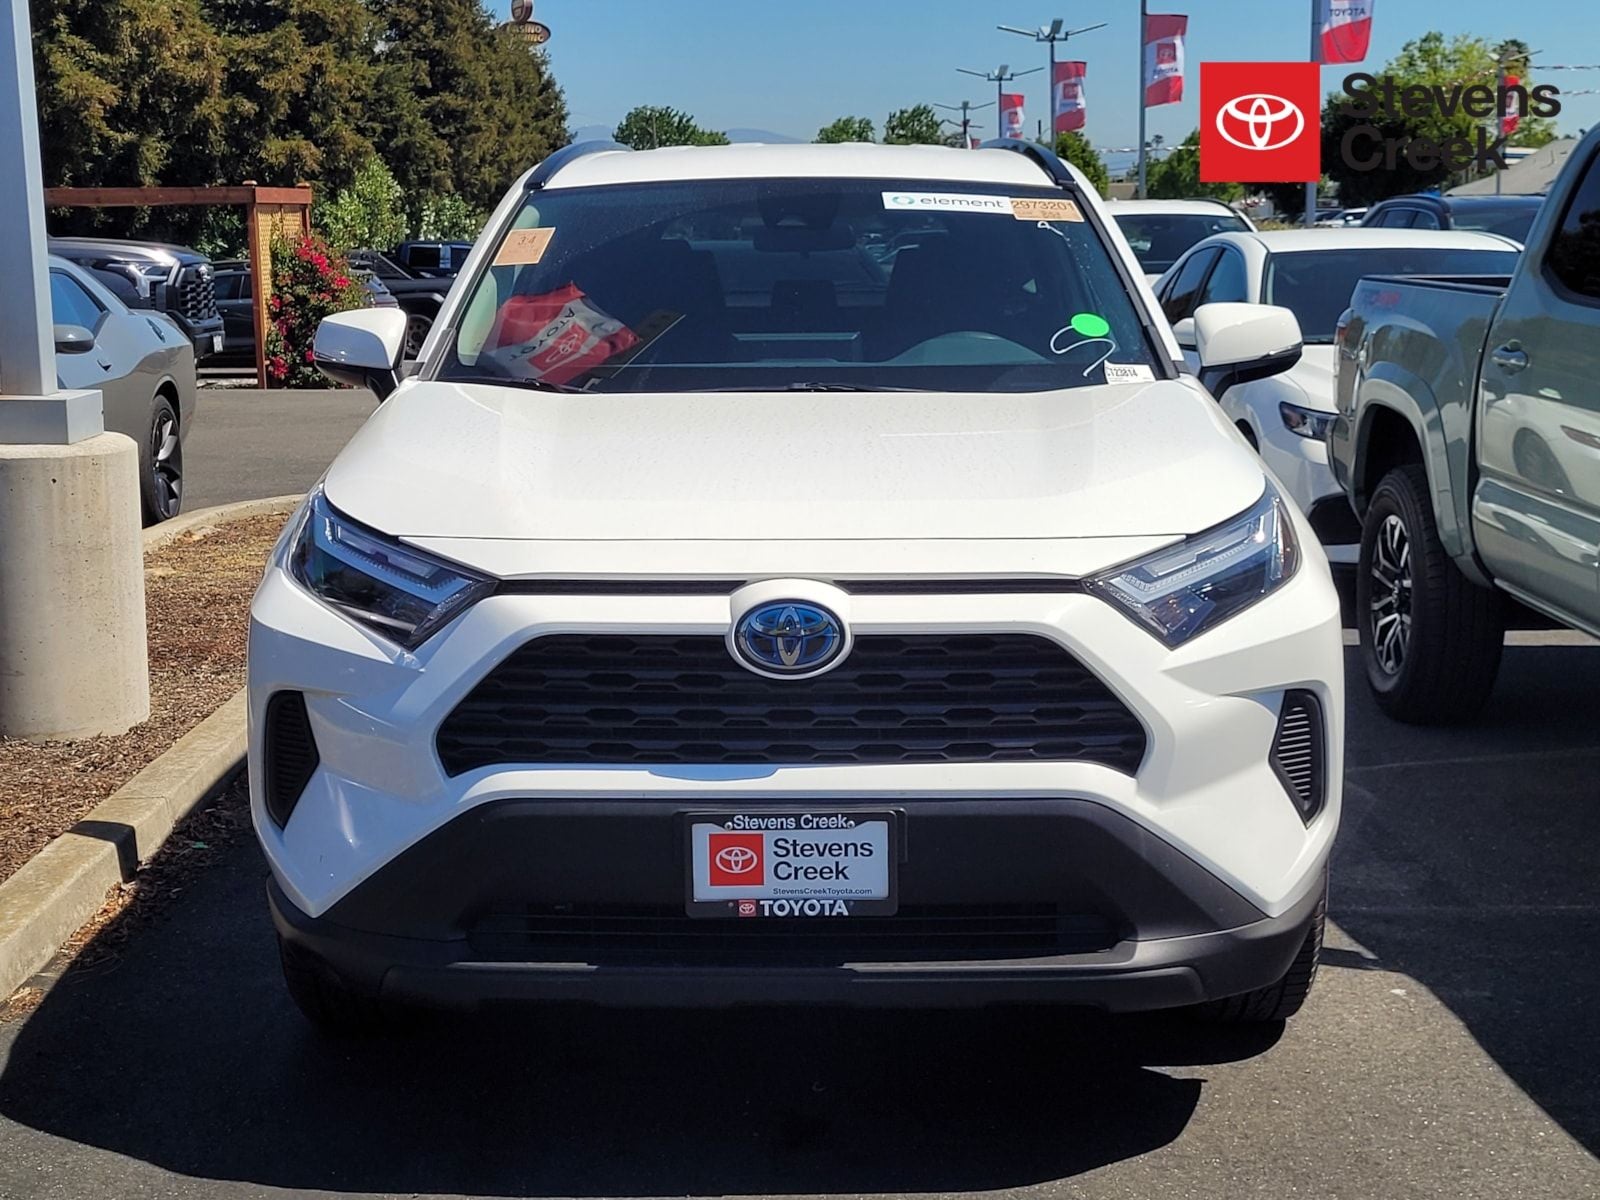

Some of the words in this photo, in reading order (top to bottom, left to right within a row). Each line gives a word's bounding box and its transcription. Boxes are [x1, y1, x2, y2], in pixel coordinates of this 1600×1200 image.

[1329, 8, 1366, 17] TOYOTA
[920, 195, 1004, 208] element
[733, 815, 796, 830] Stevens
[800, 814, 847, 829] Creek
[773, 837, 874, 858] Stevens
[773, 861, 849, 881] Creek
[773, 887, 873, 895] StevensCreekToyota.com
[760, 899, 849, 917] TOYOTA
